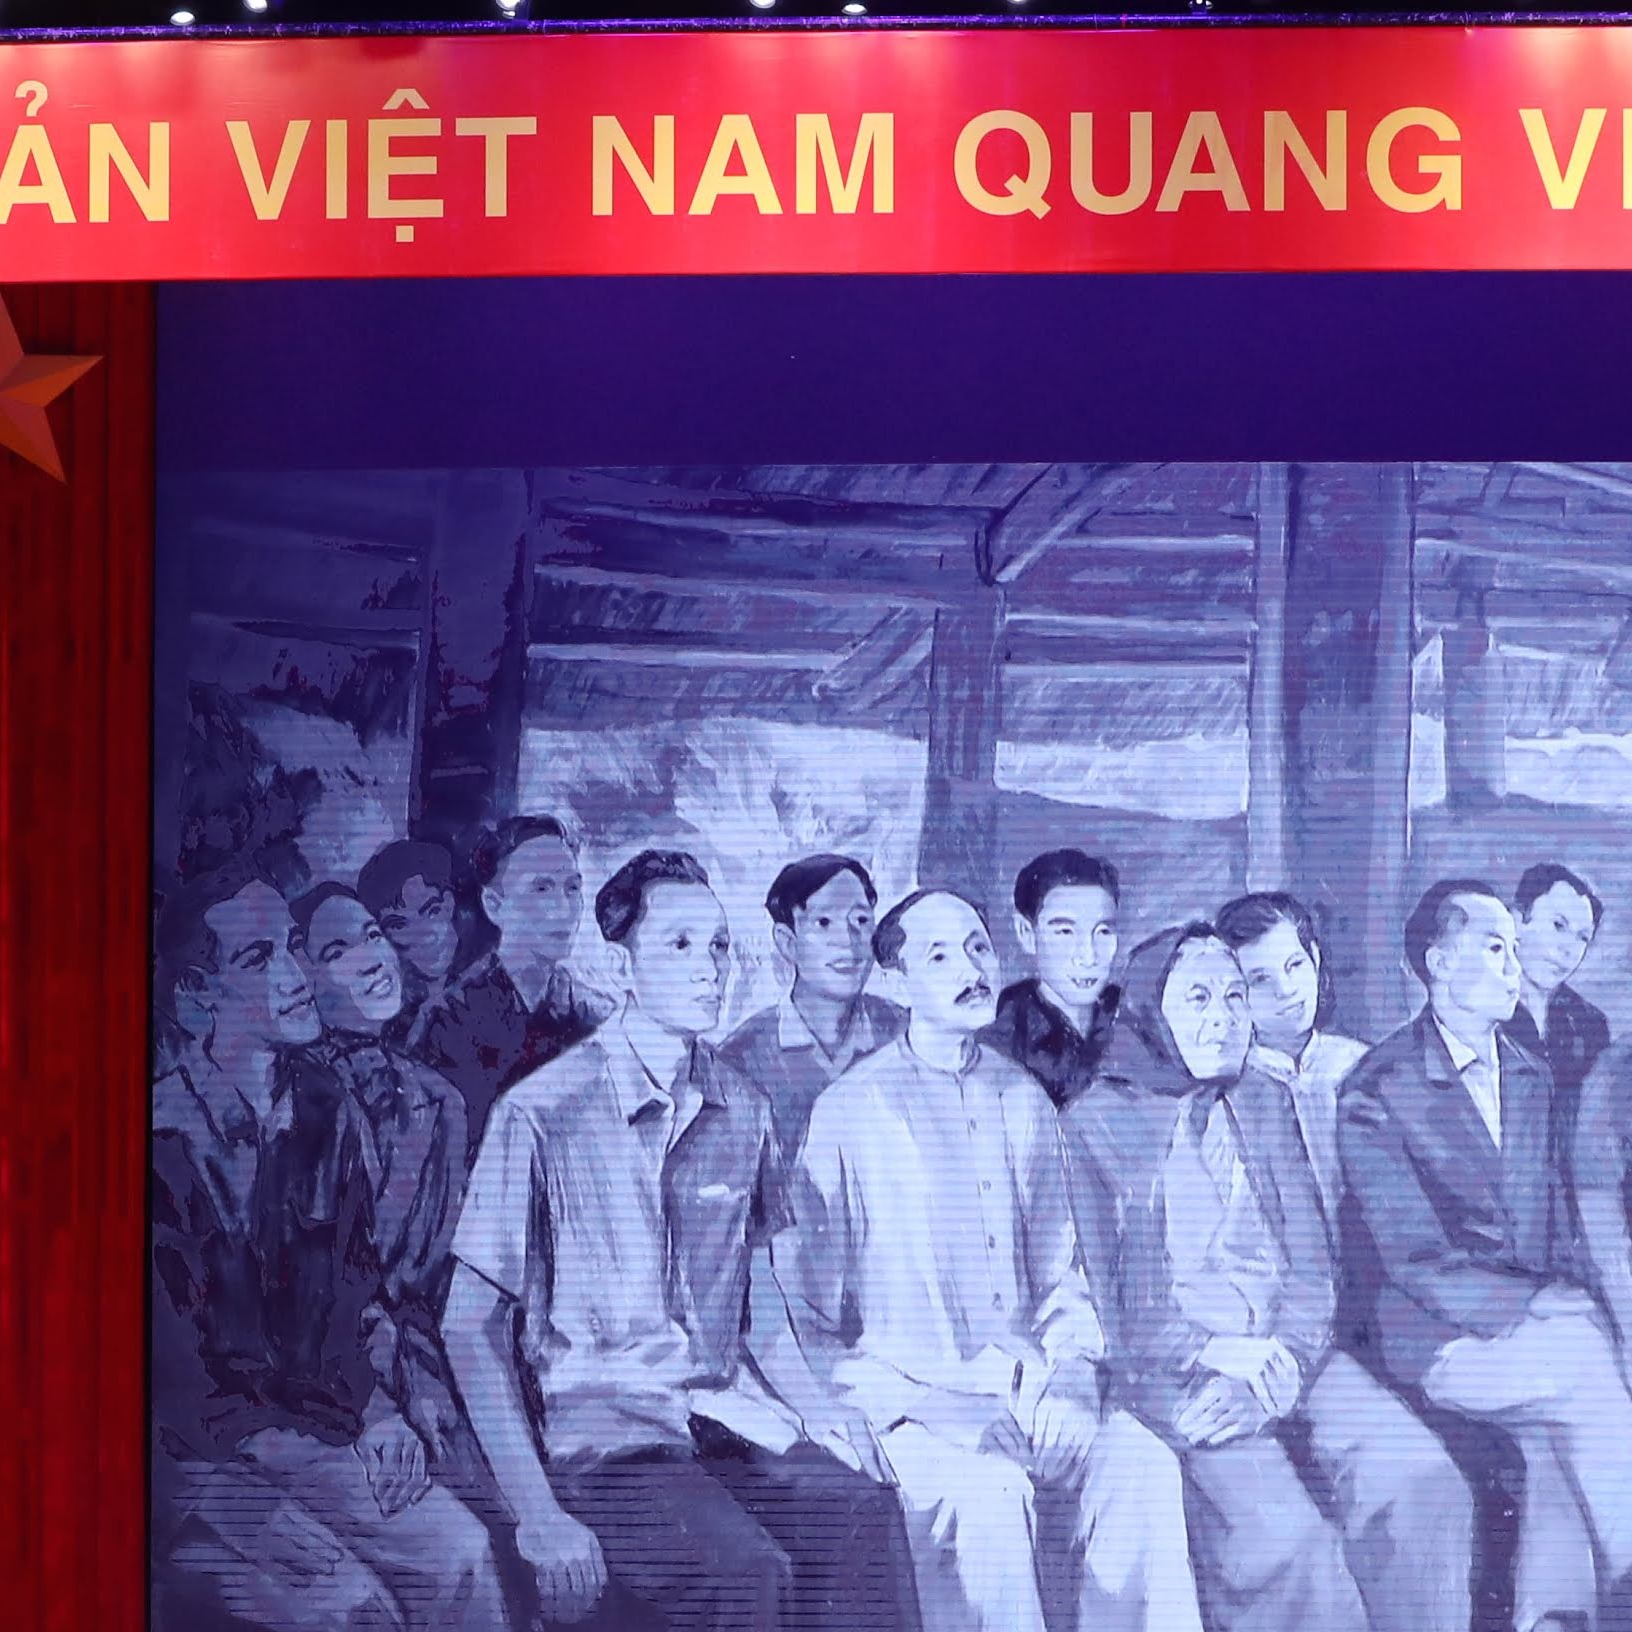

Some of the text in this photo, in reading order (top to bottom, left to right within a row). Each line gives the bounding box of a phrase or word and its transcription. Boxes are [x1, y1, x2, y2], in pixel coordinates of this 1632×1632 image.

[225, 88, 537, 242] VIỆT
[592, 111, 895, 215] NAM
[953, 107, 1462, 220] QUANG
